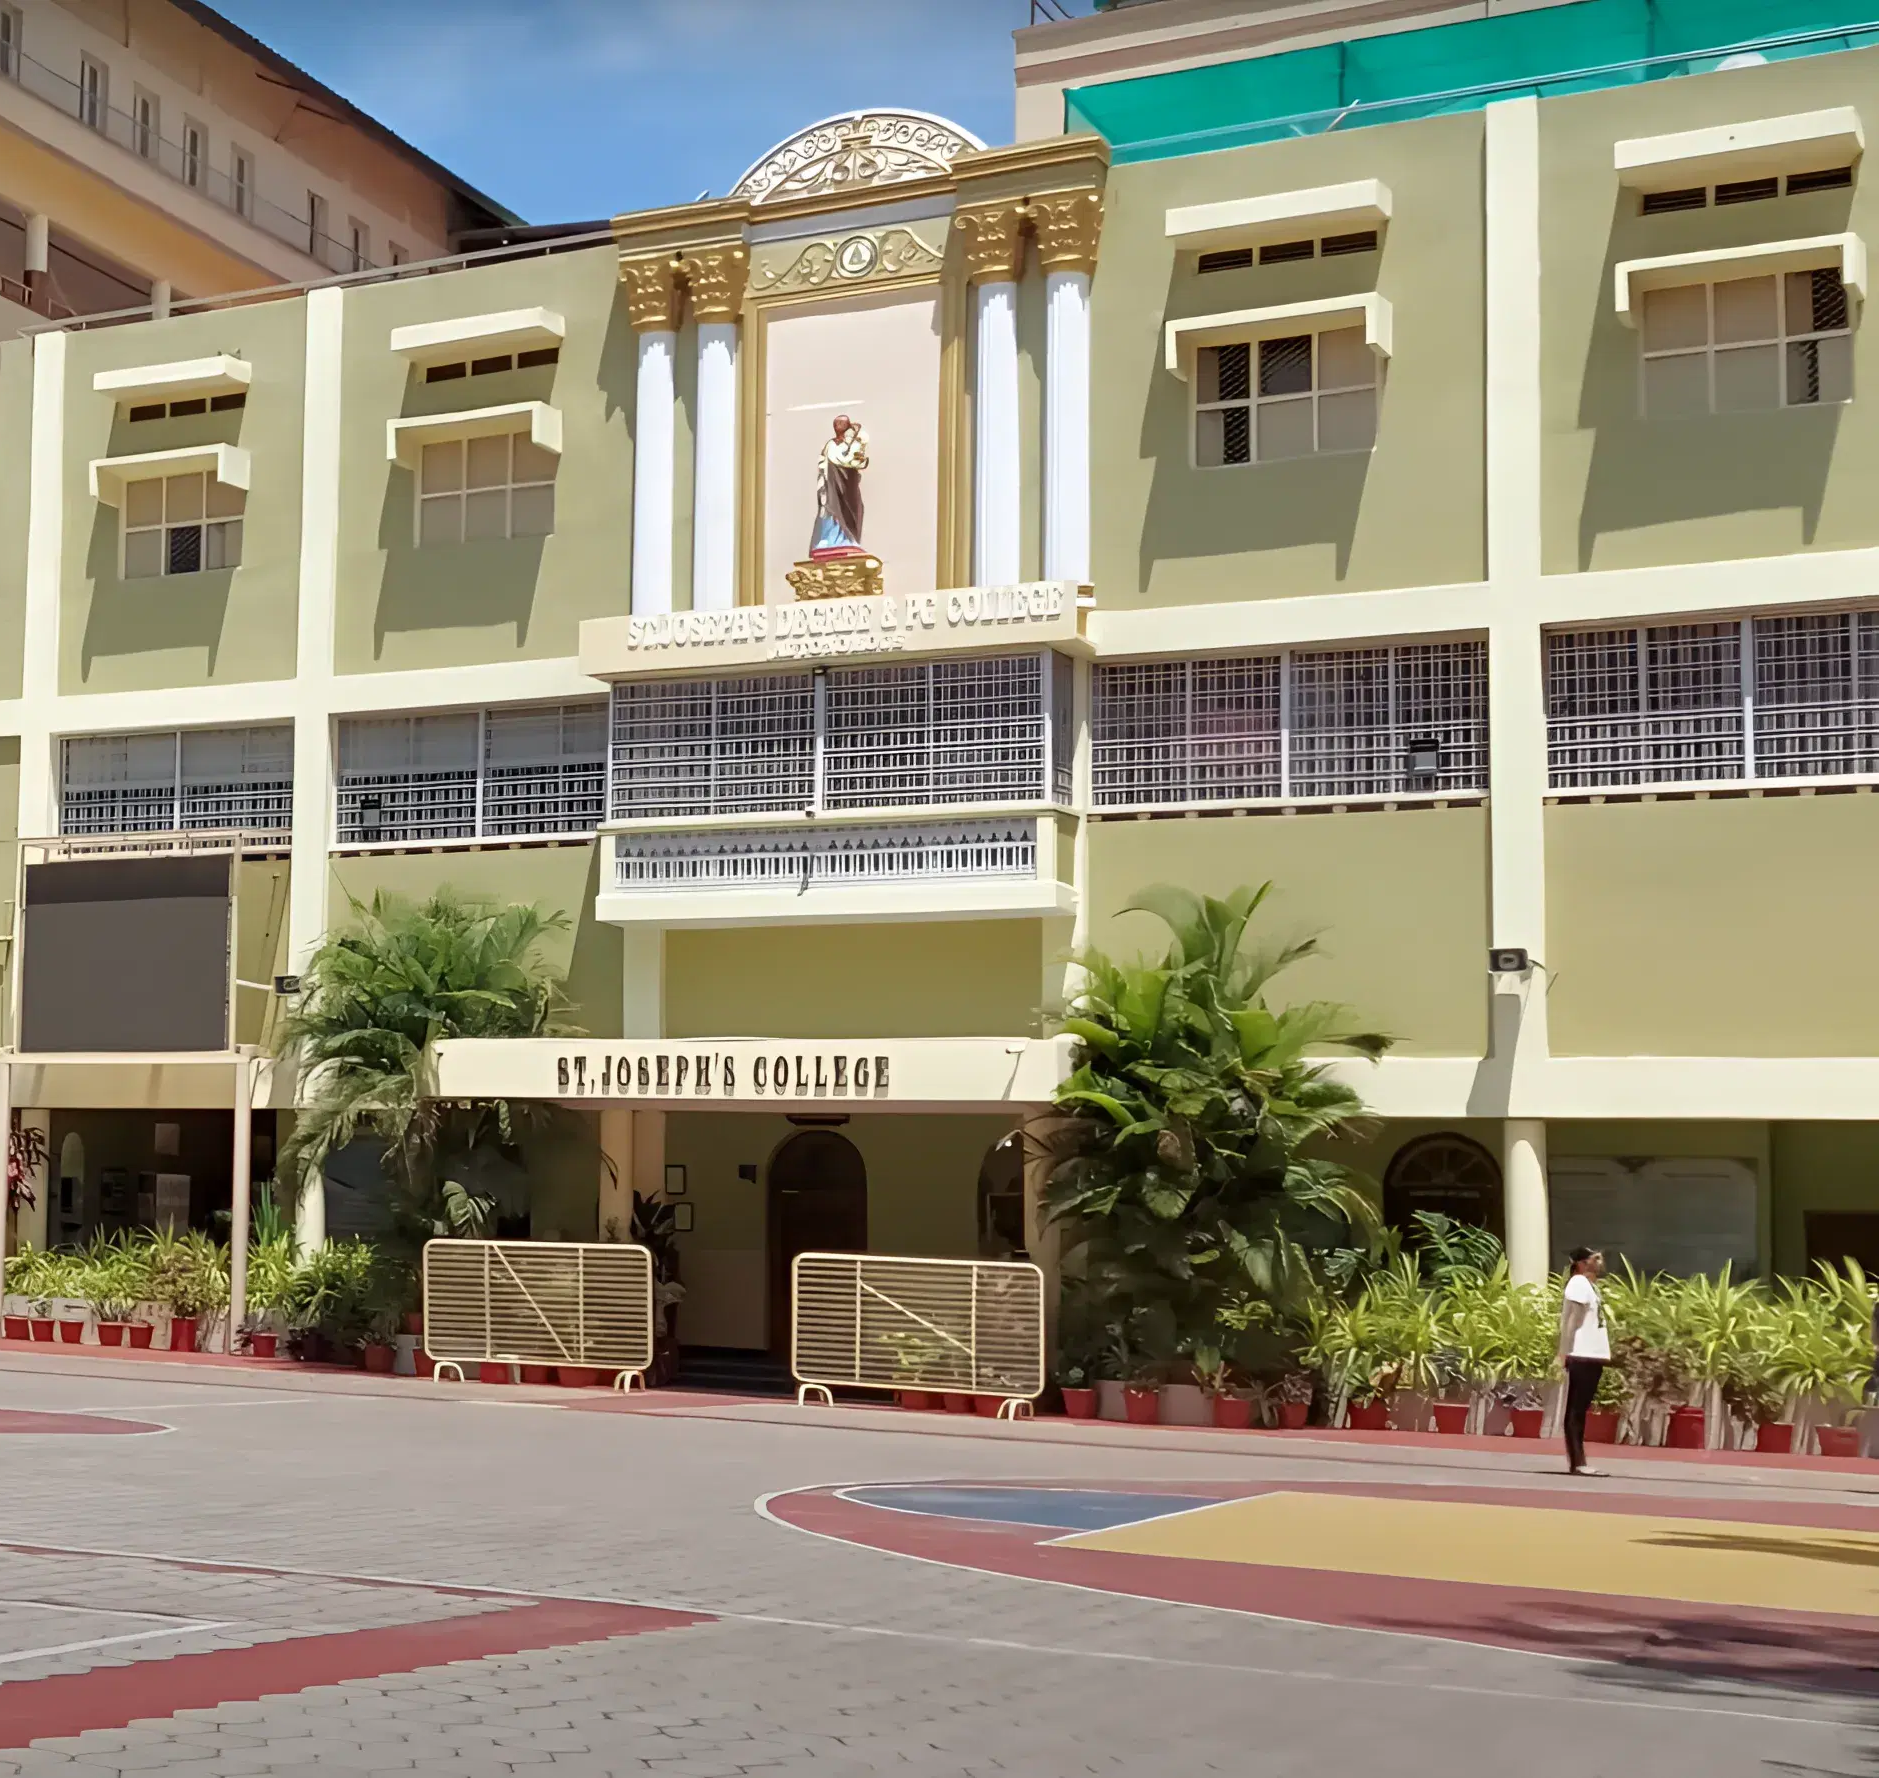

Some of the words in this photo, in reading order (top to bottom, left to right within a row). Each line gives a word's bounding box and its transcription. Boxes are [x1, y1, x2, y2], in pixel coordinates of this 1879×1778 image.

[880, 597, 898, 631] &
[905, 593, 937, 631] PG
[947, 583, 1065, 627] COLLEGE
[753, 1056, 890, 1097] COLLEGE
